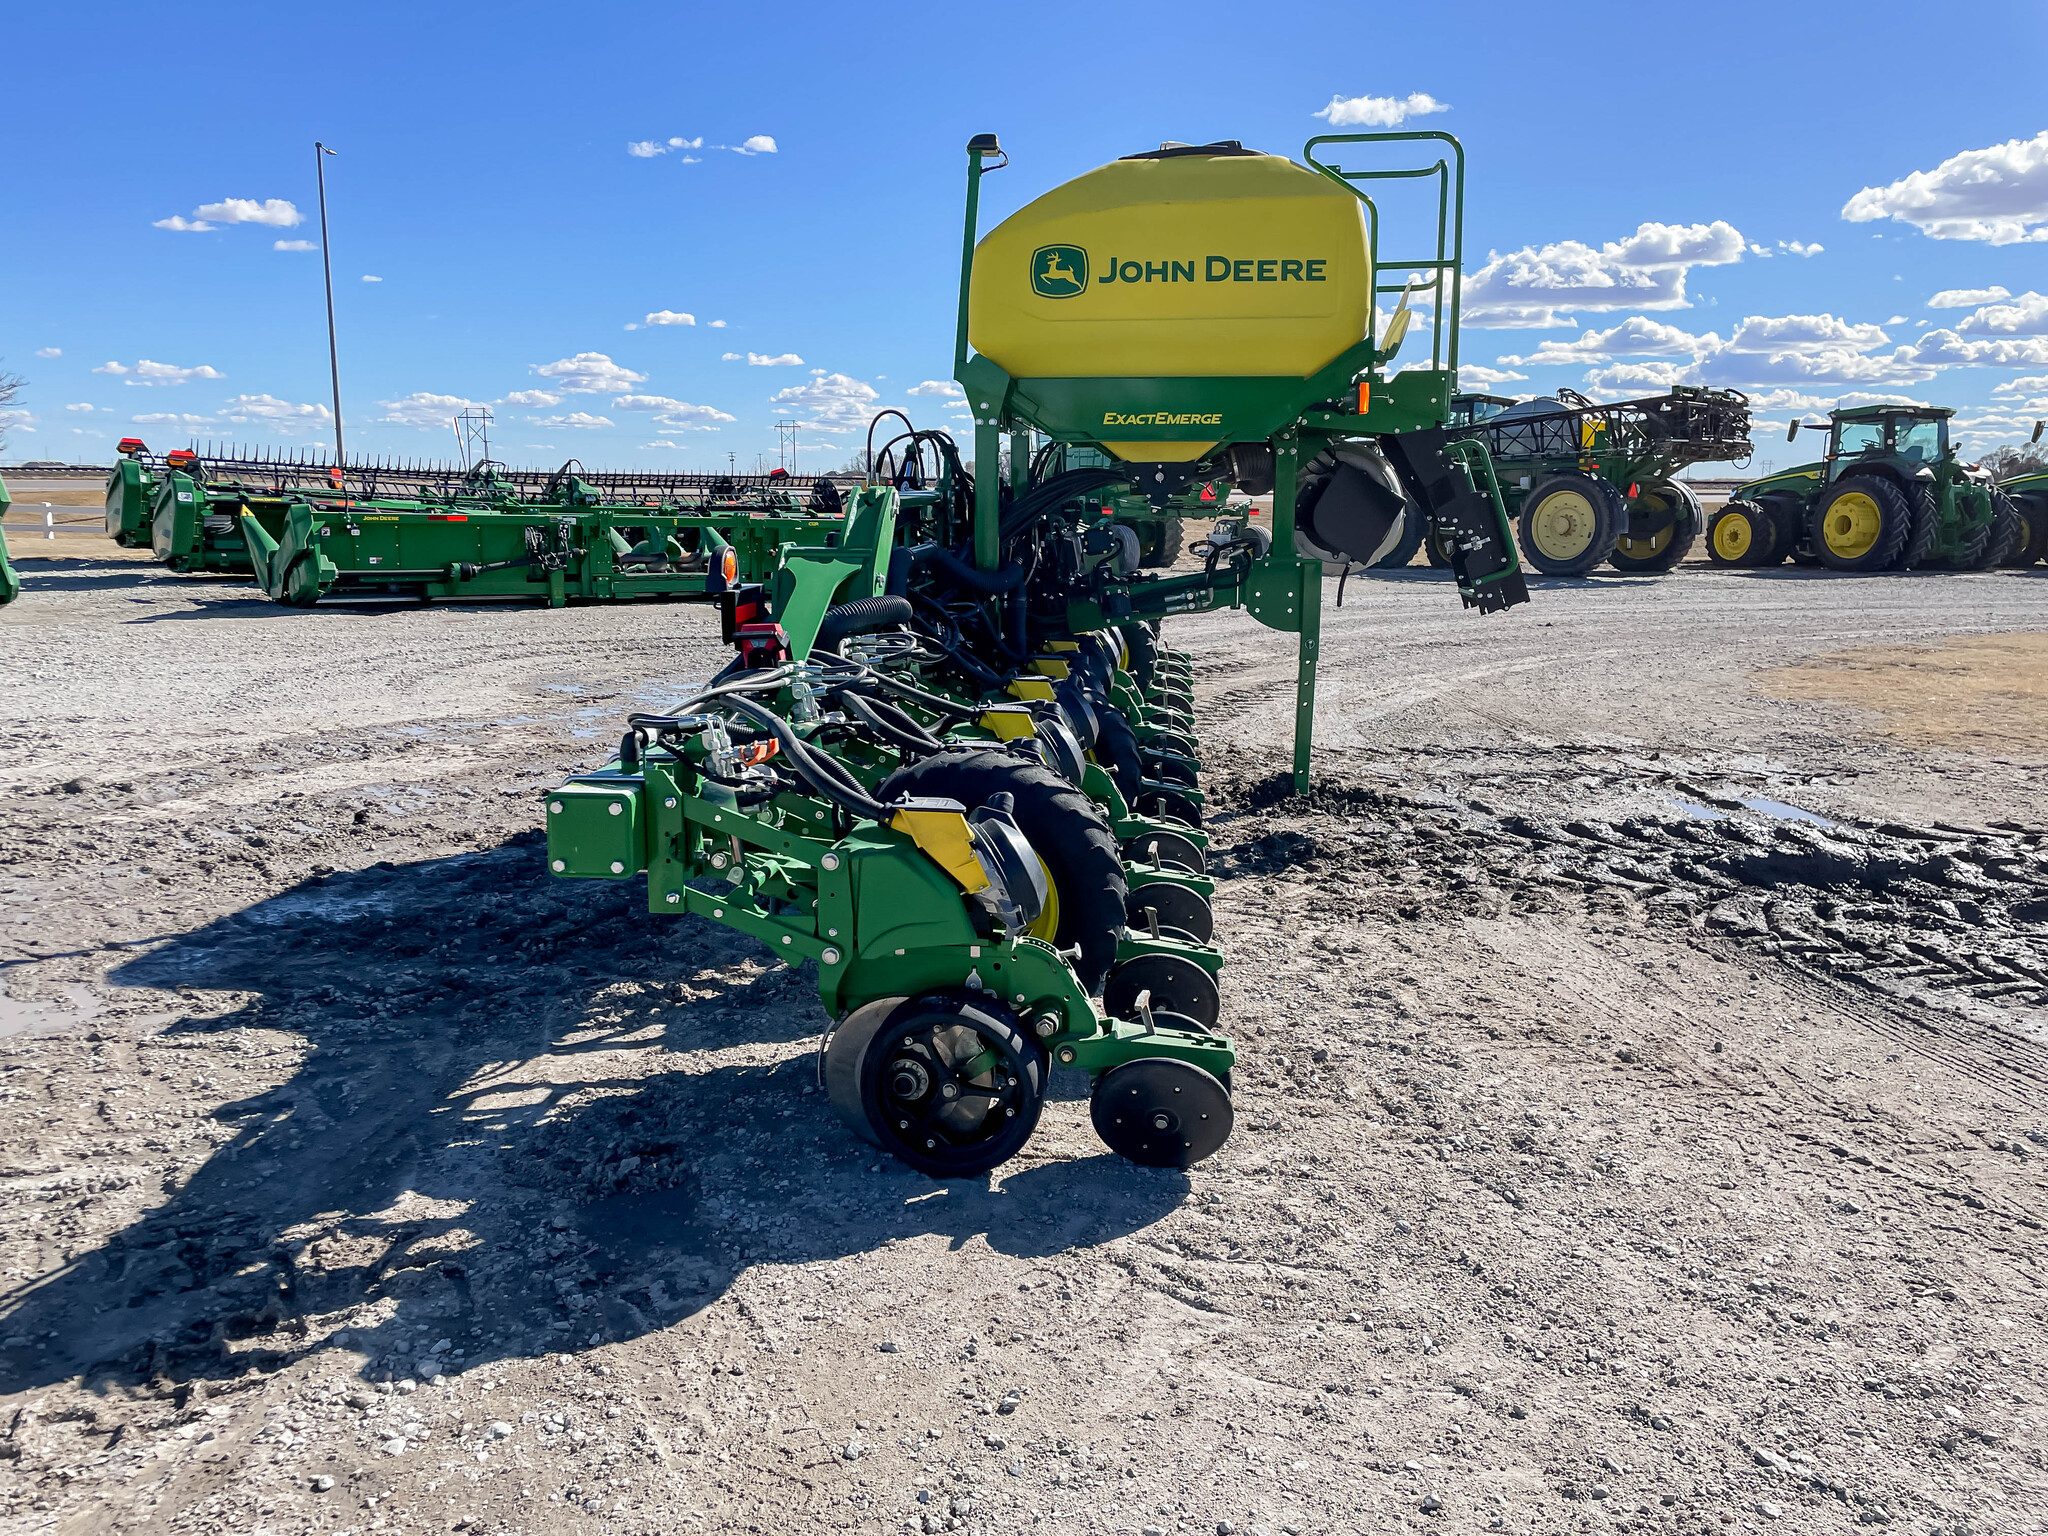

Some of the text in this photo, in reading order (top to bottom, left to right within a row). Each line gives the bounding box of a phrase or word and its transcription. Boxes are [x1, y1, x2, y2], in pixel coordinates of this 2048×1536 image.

[1098, 255, 1327, 284] JOHN DEERE
[1102, 411, 1223, 425] EXACTEMERGE
